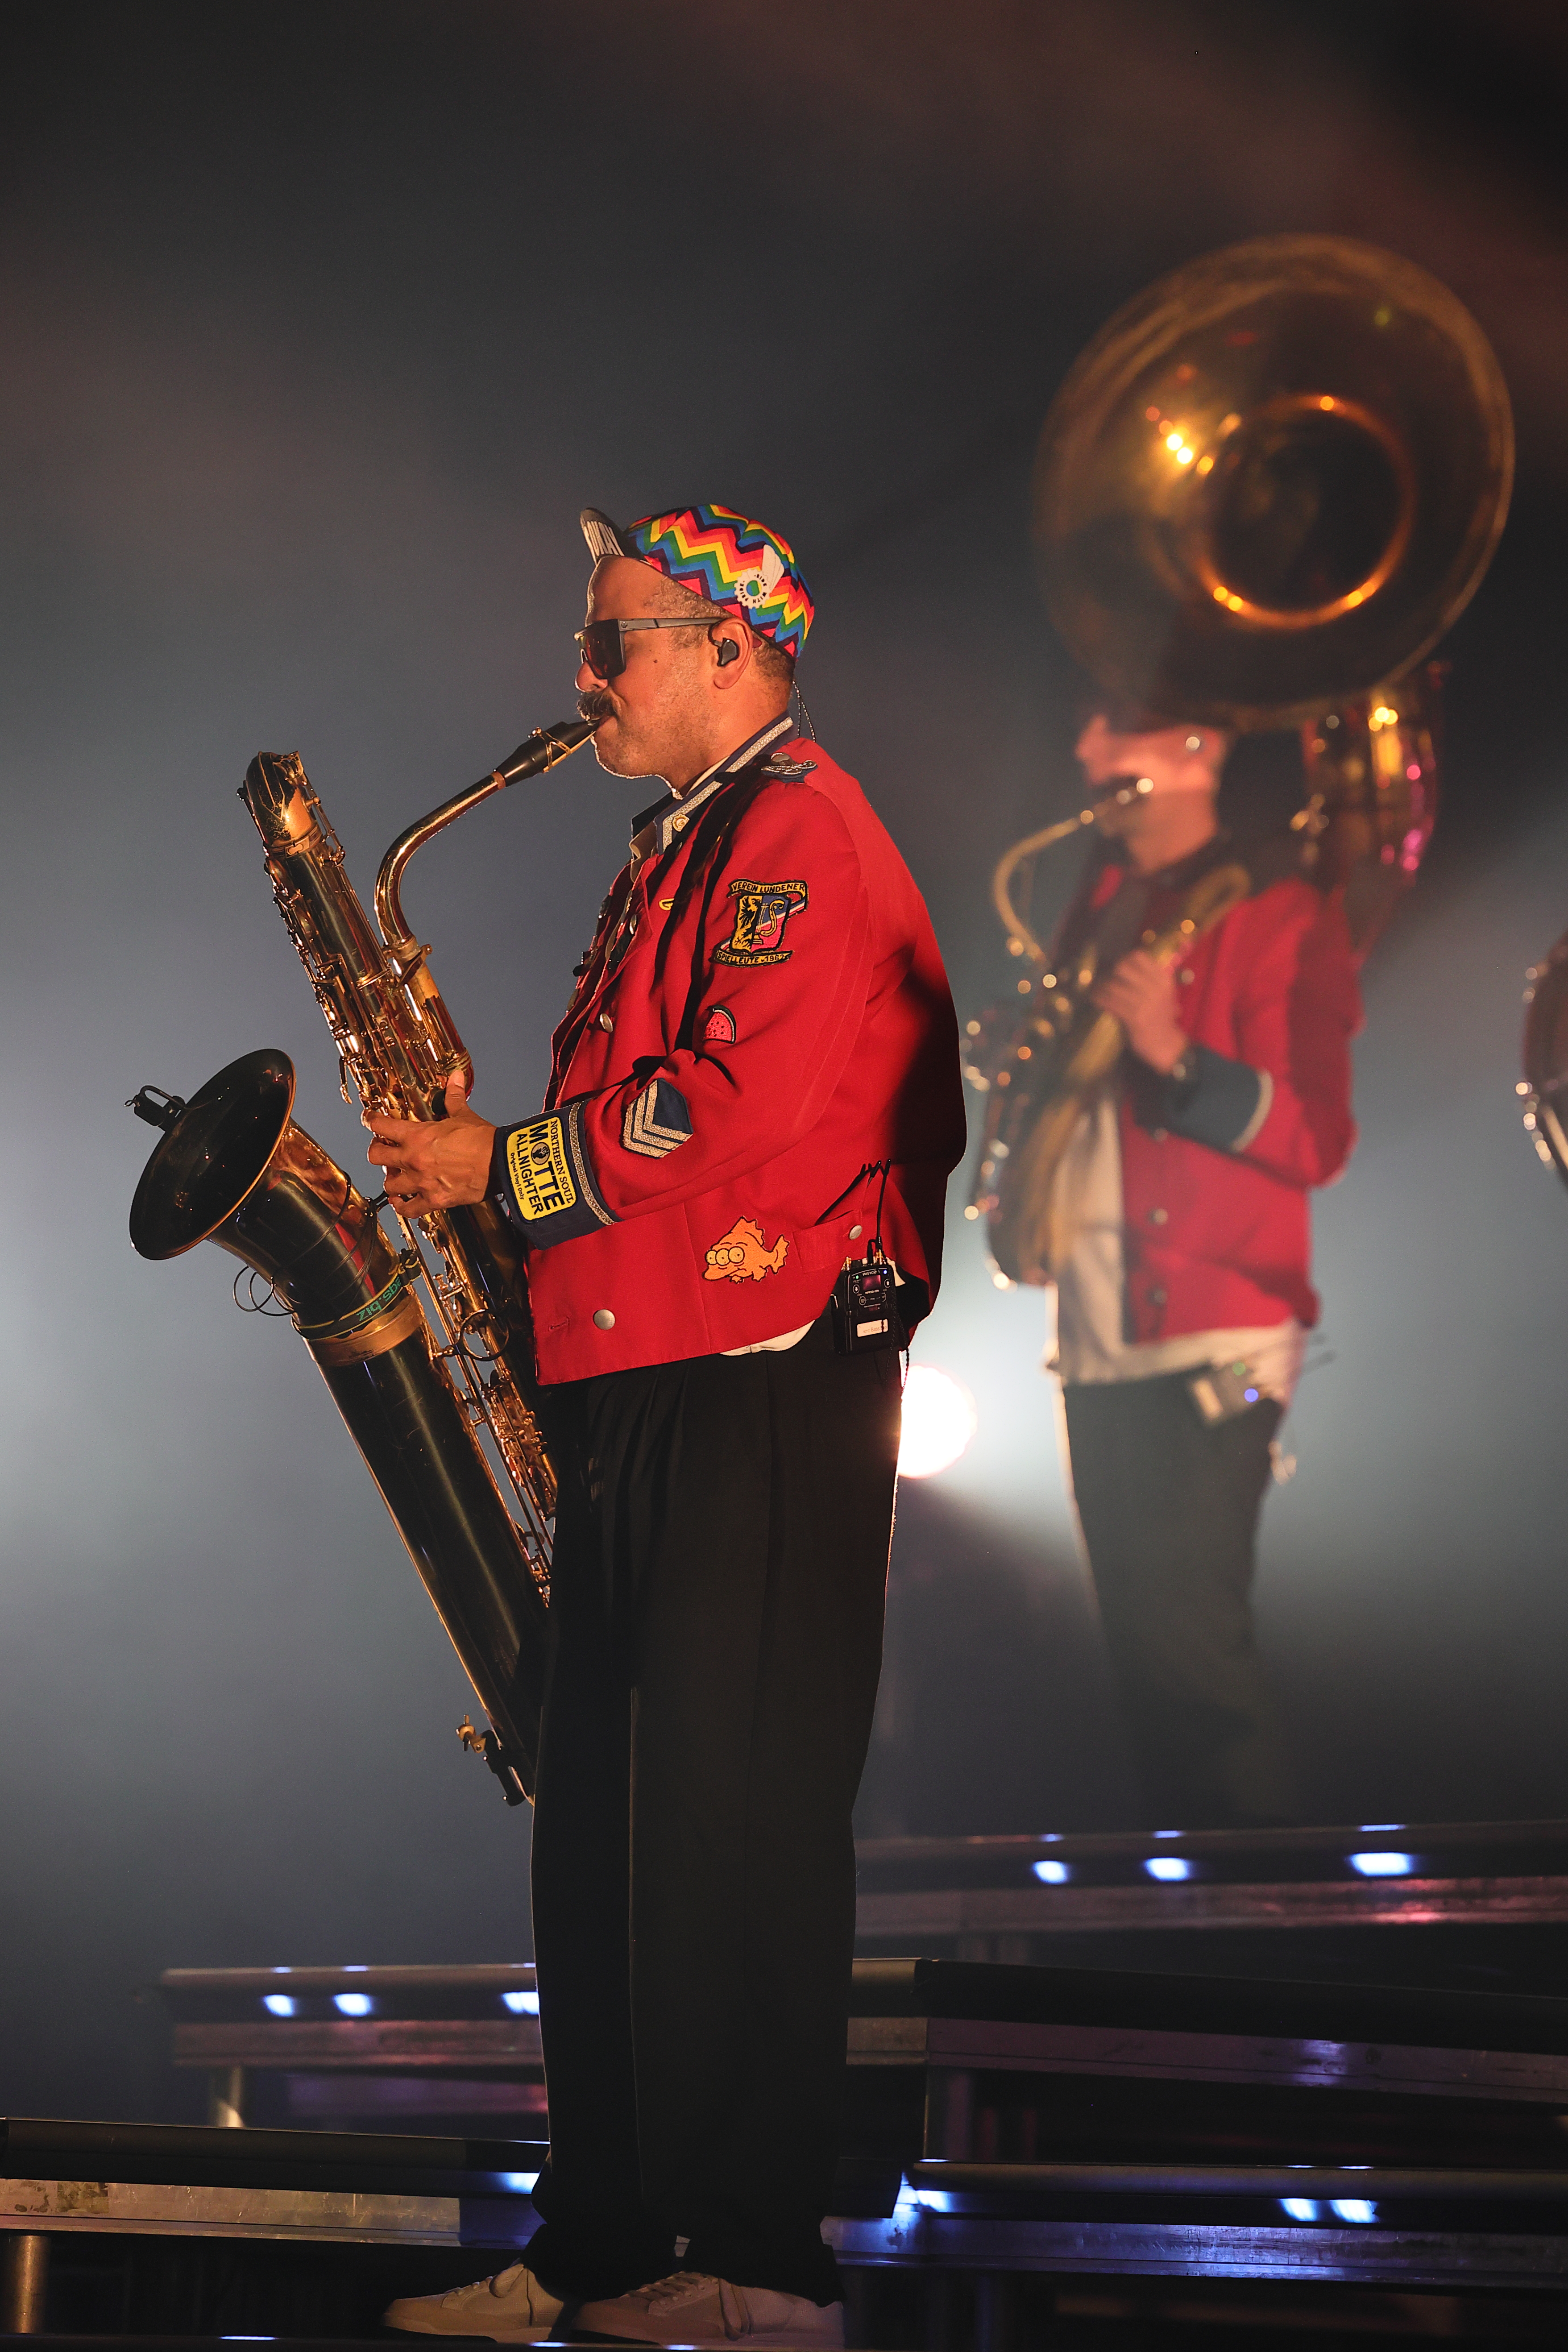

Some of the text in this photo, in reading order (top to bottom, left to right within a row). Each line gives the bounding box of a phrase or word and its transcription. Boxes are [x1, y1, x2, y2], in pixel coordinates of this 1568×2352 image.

[739, 573, 767, 604] RIDE WITH PRIDE
[733, 882, 805, 893] VEREIN LUNDENER
[718, 951, 759, 964] SPIELLEUTE
[510, 1152, 518, 1172] Original
[550, 1119, 574, 1203] NORTHERN SOUL
[517, 1133, 544, 1215] ALLNIGHTER
